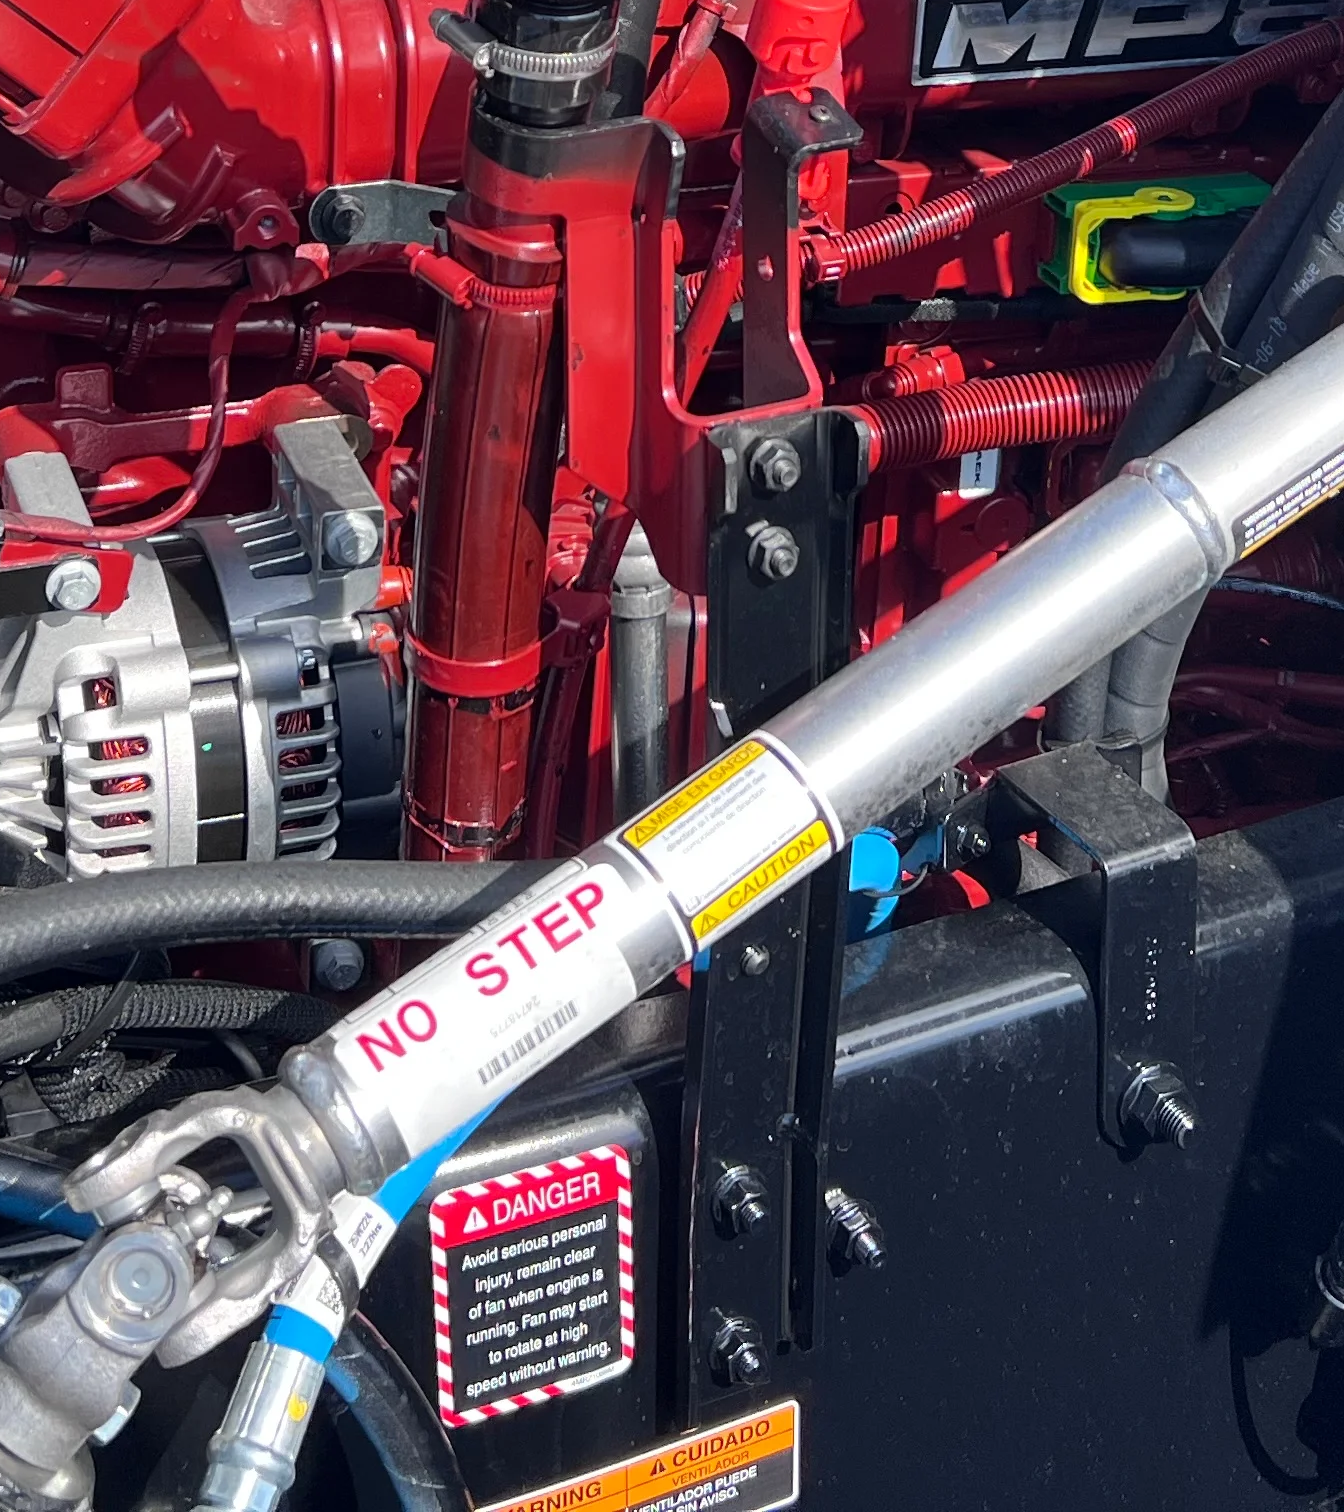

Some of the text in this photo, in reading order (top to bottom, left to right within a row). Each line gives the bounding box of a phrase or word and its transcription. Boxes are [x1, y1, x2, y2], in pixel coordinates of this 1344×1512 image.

[1291, 262, 1321, 299] Made
[1316, 237, 1333, 257] in
[650, 743, 758, 828] MISE EN GARDE
[727, 833, 816, 910] CAUTION
[355, 1000, 437, 1073] NO
[464, 881, 604, 996] STEP
[493, 1171, 601, 1226] DANGER
[462, 1213, 607, 1271] Avoid serious personal
[468, 1268, 604, 1320] of fan when engine is
[475, 1245, 596, 1294] injury, remain clear
[466, 1289, 608, 1347] running. Fan may start
[488, 1322, 588, 1364] to rotate at high
[466, 1371, 506, 1399] speed
[509, 1358, 555, 1385] without
[558, 1339, 612, 1368] warning.
[672, 1419, 770, 1467] CUIDADO
[672, 1450, 750, 1487] VENTILADOR
[504, 1480, 602, 1512] ARNING
[699, 1487, 740, 1509] AVISO.
[715, 1464, 758, 1489] PUEDE
